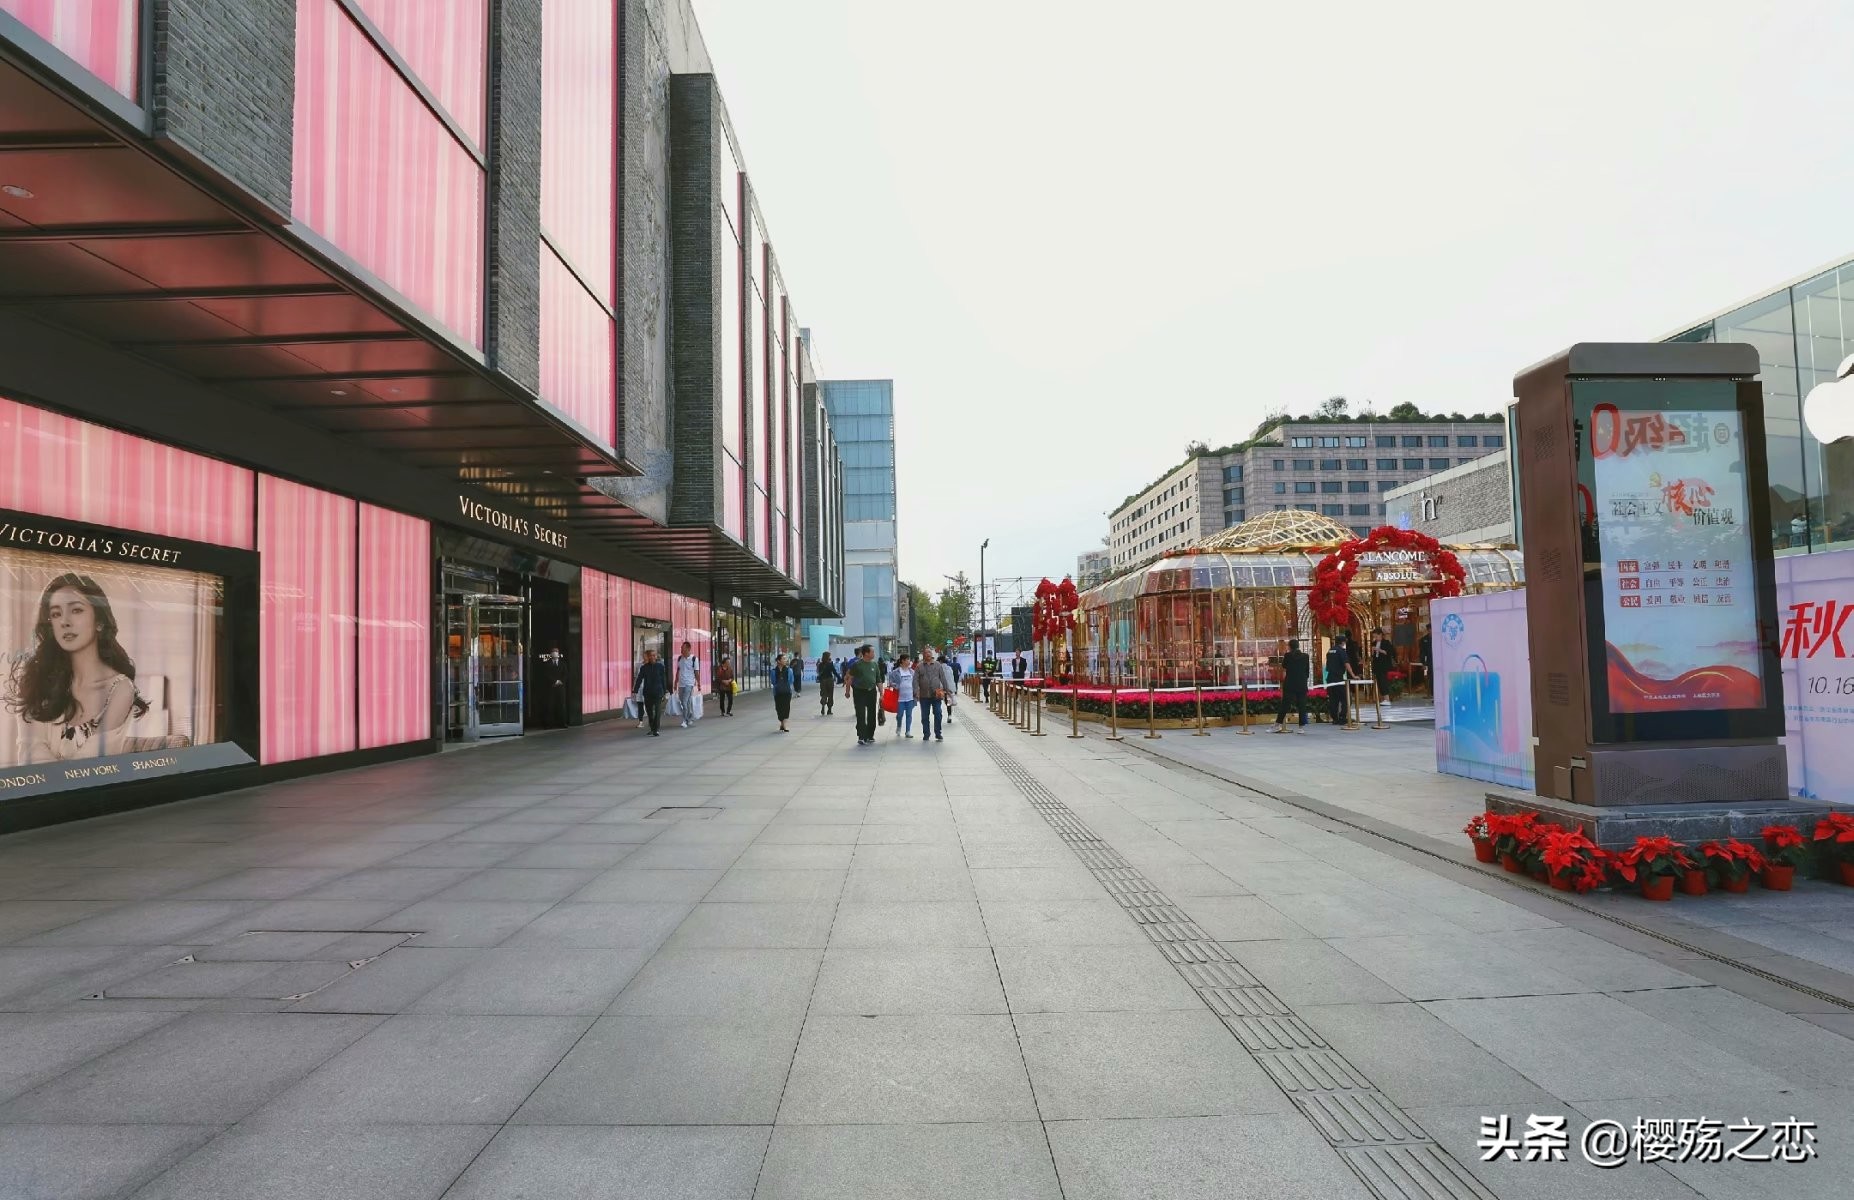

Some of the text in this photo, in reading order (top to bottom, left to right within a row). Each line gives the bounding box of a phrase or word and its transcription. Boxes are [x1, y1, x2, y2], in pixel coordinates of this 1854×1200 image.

[1662, 478, 1715, 516] 核心
[460, 495, 568, 549] VICTORIA'S SECRET
[1693, 508, 1734, 525] 价值观
[119, 542, 182, 564] SECRET
[1368, 549, 1426, 562] LANCÔME
[64, 768, 91, 780] NEW
[93, 764, 120, 776] YORK
